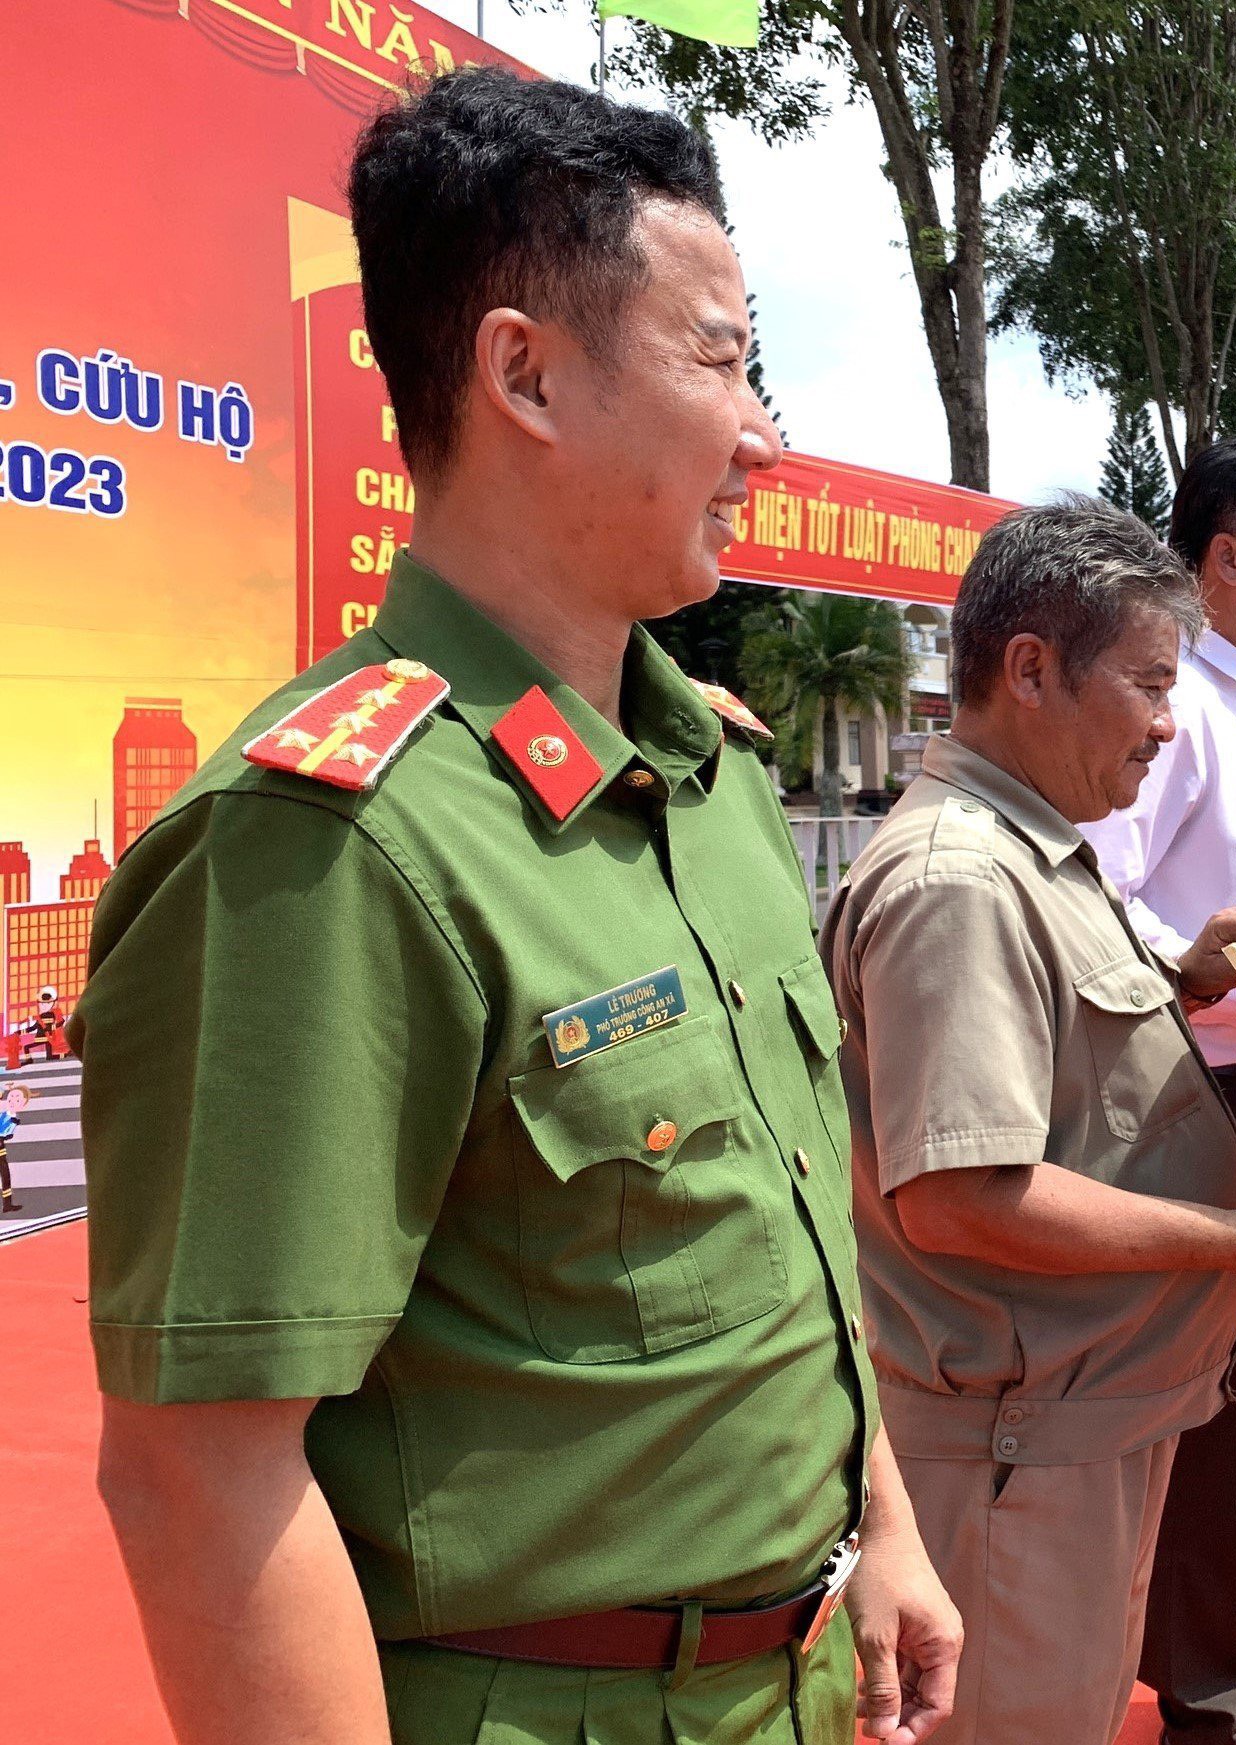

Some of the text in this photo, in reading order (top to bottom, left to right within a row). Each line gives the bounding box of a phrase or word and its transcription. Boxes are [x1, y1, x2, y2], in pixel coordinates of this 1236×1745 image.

[37, 349, 252, 461] CỨU HỘ
[0, 442, 125, 517] 023
[754, 480, 802, 561] HIỆN
[806, 482, 841, 556] TỐT
[843, 499, 886, 573] LUẬT
[888, 505, 942, 573] PHÒNG
[596, 1018, 611, 1034] PHÓ
[637, 1002, 655, 1017] CÔNG
[656, 997, 665, 1010] AN
[607, 995, 620, 1014] LÊ
[609, 1024, 634, 1041] 469
[646, 1009, 668, 1025] 407
